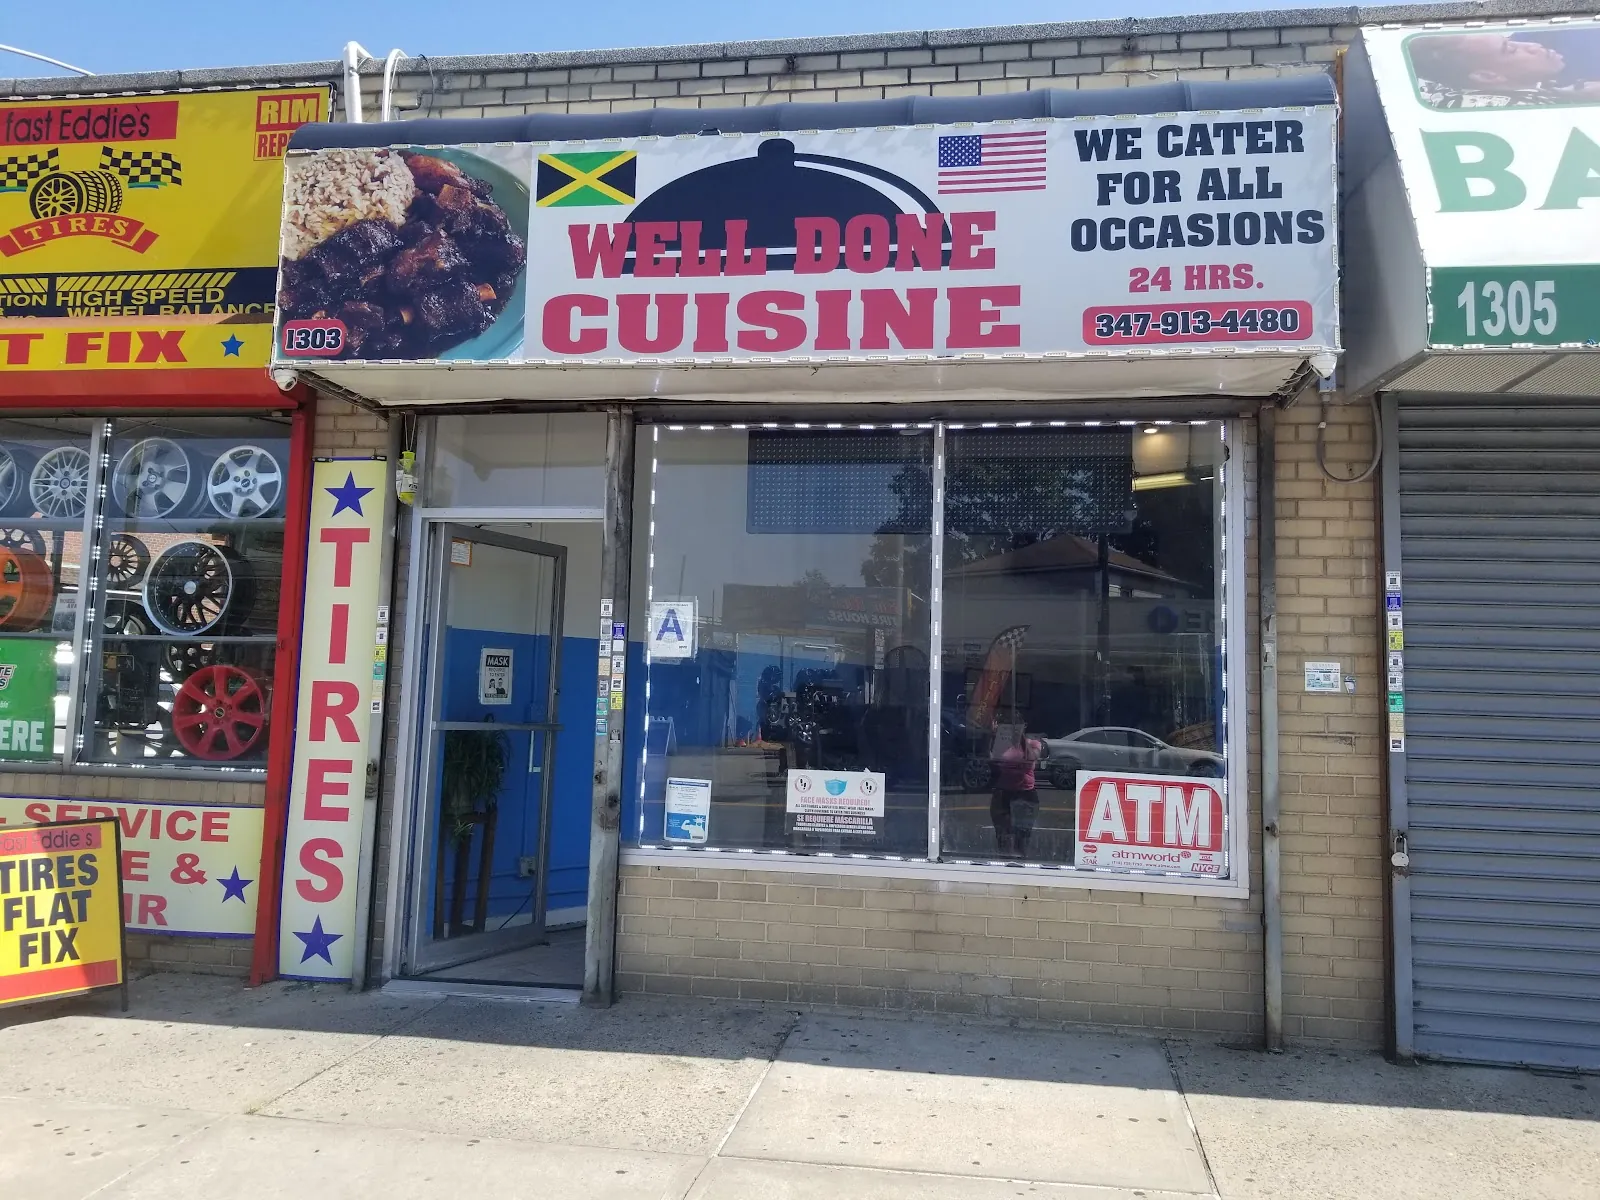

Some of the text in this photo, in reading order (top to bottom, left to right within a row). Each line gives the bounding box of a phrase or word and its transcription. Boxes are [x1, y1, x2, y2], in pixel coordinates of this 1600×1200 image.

[6, 111, 52, 142] fast
[260, 98, 318, 125] RIM
[257, 132, 292, 158] REP
[1074, 119, 1305, 162] WE CATER
[1096, 166, 1283, 207] FOR ALL
[1419, 126, 1600, 213] BA
[24, 216, 130, 242] TIRES
[568, 210, 996, 280] WELL DONE
[1070, 209, 1325, 253] OCCASIONS
[1128, 263, 1264, 293] 24 HRS.
[56, 290, 124, 307] HIGH
[131, 287, 225, 305] SPEED
[1457, 279, 1558, 338] 1305
[542, 284, 1022, 355] CUISINE
[1095, 307, 1299, 338] 347-913-4480
[65, 330, 188, 365] FIX
[284, 326, 343, 351] 1303
[656, 608, 685, 641] A
[486, 656, 509, 667] MASK
[294, 527, 371, 903] TIRES
[1085, 781, 1213, 849] ATM
[0, 853, 99, 893] TIRES
[170, 852, 208, 886] &
[1111, 849, 1181, 863] atmworld
[1192, 863, 1219, 873] NYCE
[4, 889, 92, 933] FLAT
[19, 927, 81, 969] FIX
